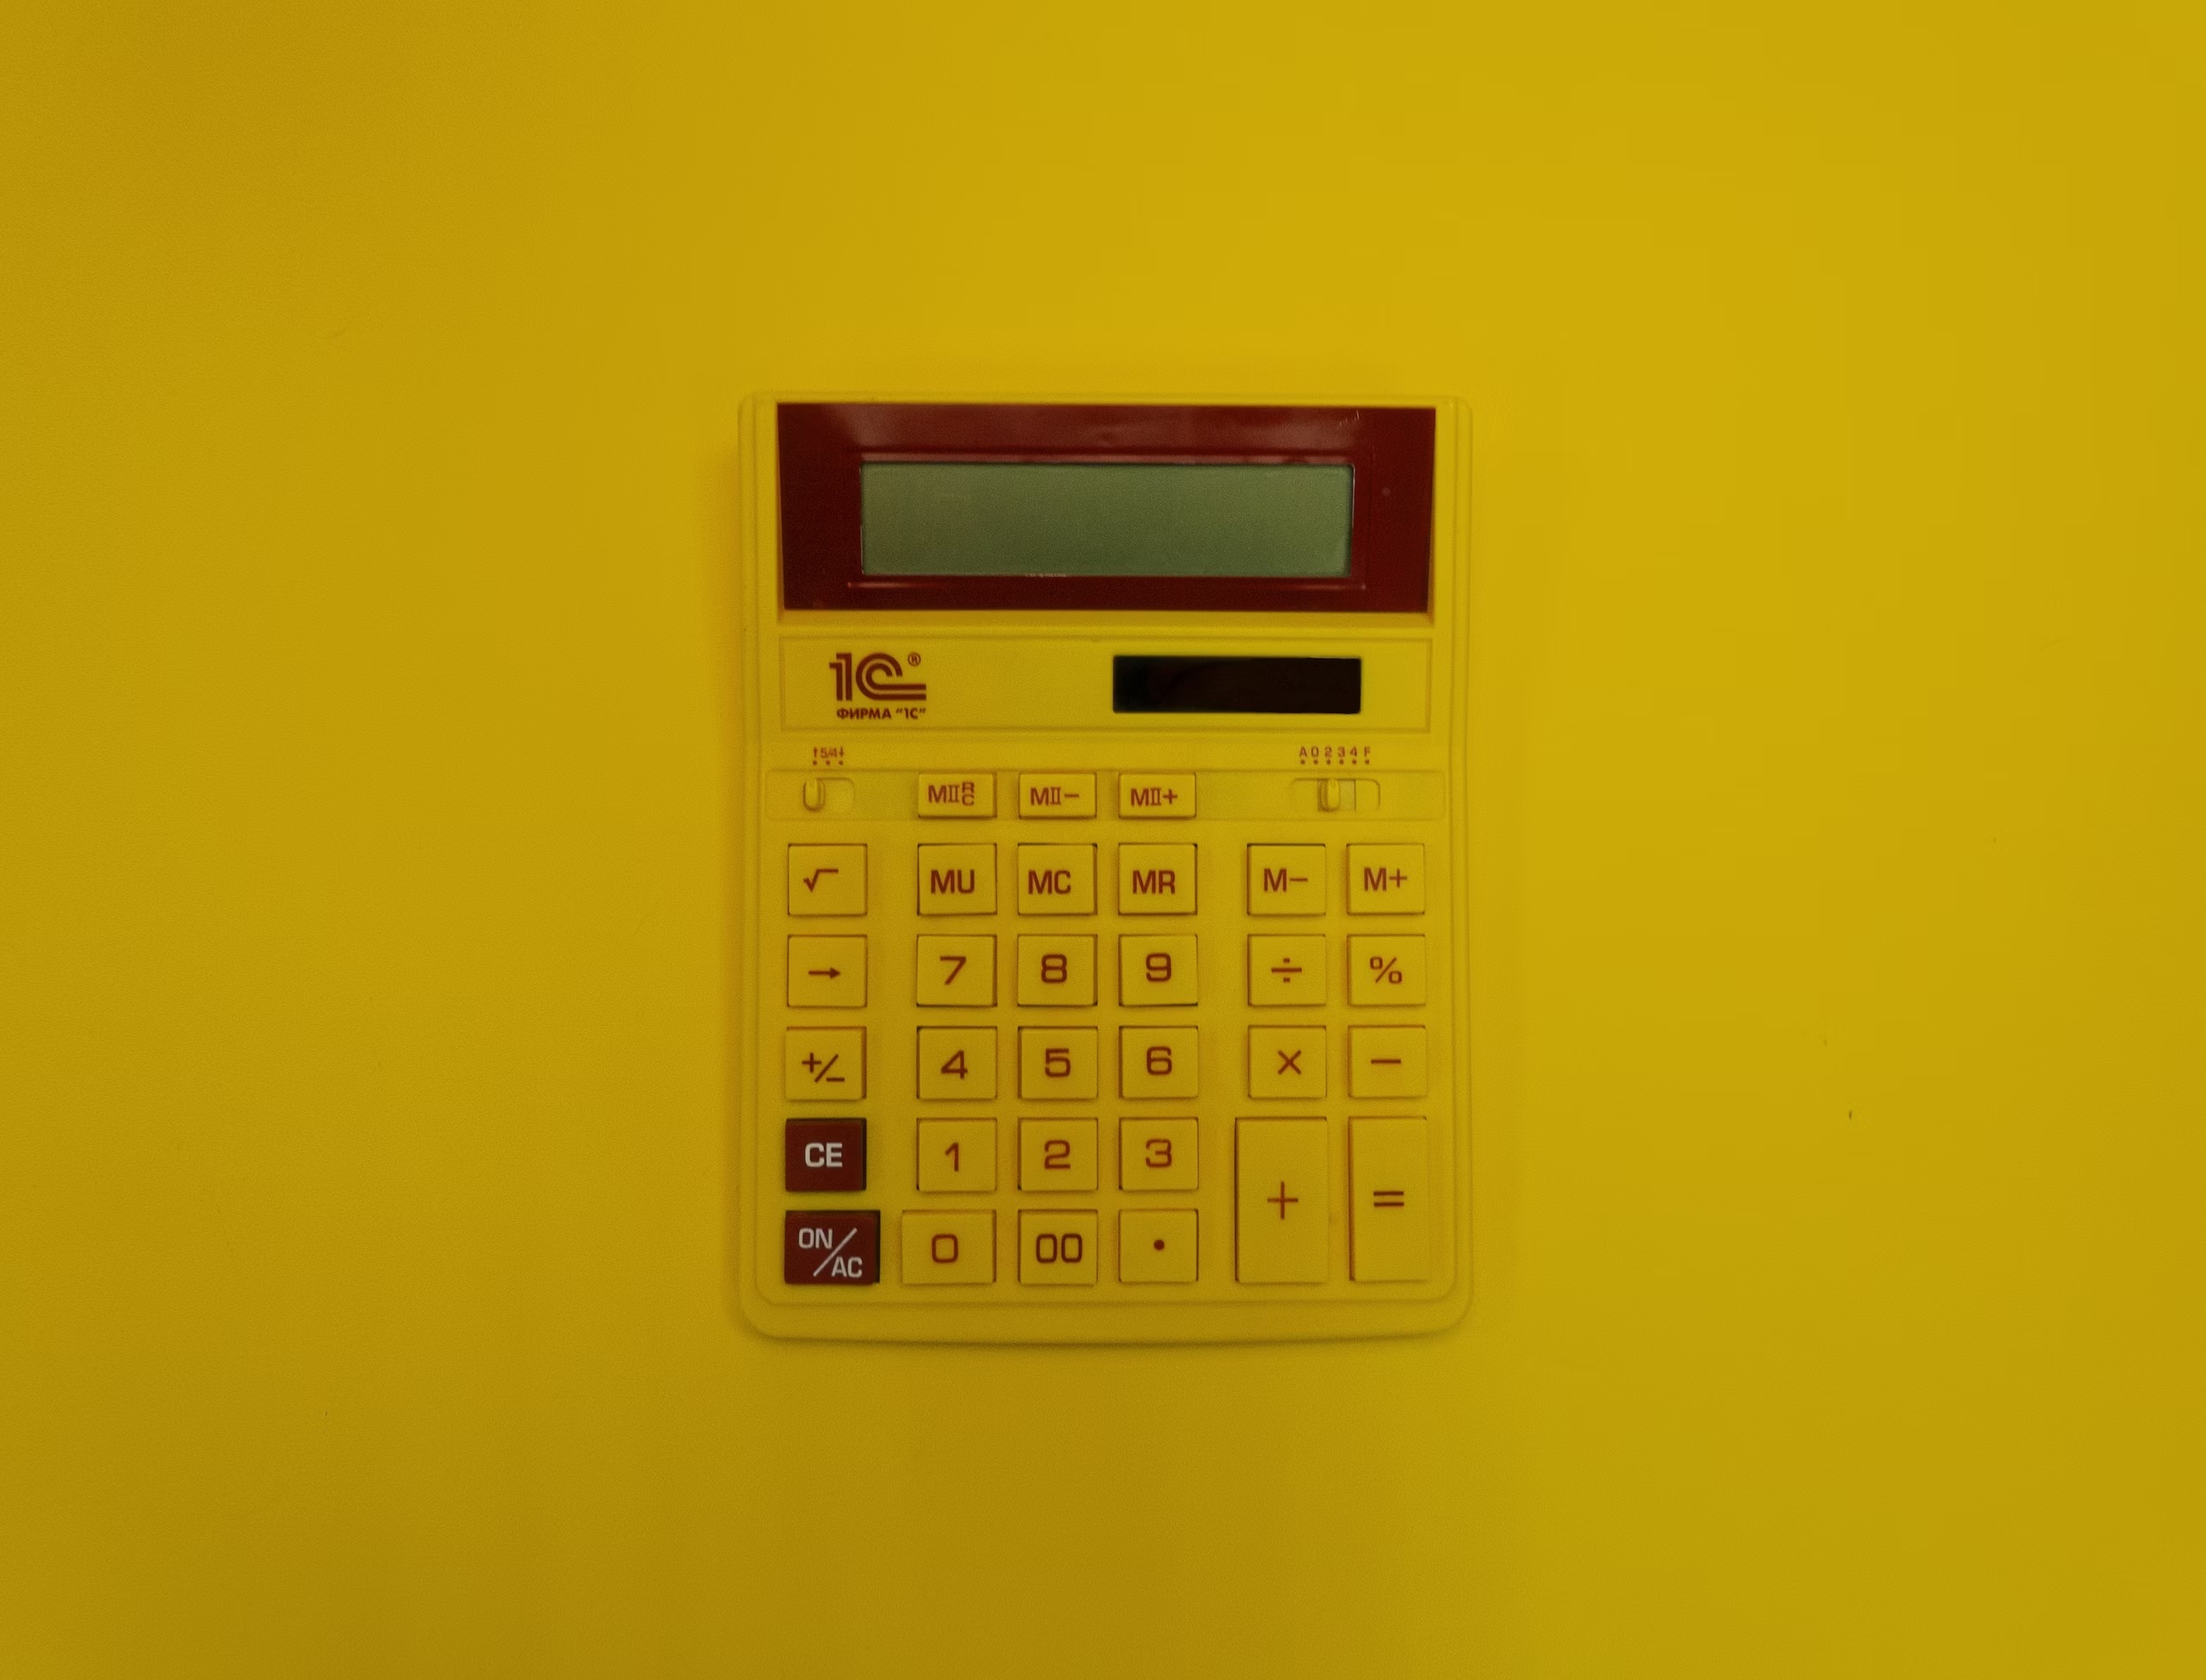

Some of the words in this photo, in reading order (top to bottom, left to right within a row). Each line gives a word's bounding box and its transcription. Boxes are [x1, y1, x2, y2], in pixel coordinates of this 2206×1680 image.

[836, 707, 892, 719] ФИРМА
[1350, 746, 1357, 757] 4
[931, 869, 975, 894] MU
[1028, 870, 1071, 895] MC
[1132, 870, 1175, 895] MR
[1364, 867, 1407, 891] M+
[939, 955, 966, 985] 7
[1041, 953, 1068, 984] 8
[1145, 952, 1172, 983] 9
[940, 1050, 968, 1080] 4
[1044, 1048, 1071, 1078] 5
[1146, 1045, 1173, 1076] 6
[805, 1143, 842, 1167] CE
[945, 1143, 959, 1172] 1
[1044, 1139, 1070, 1170] 2
[1145, 1138, 1172, 1169] 3
[931, 1233, 959, 1264] 0
[1036, 1233, 1082, 1264] 00
